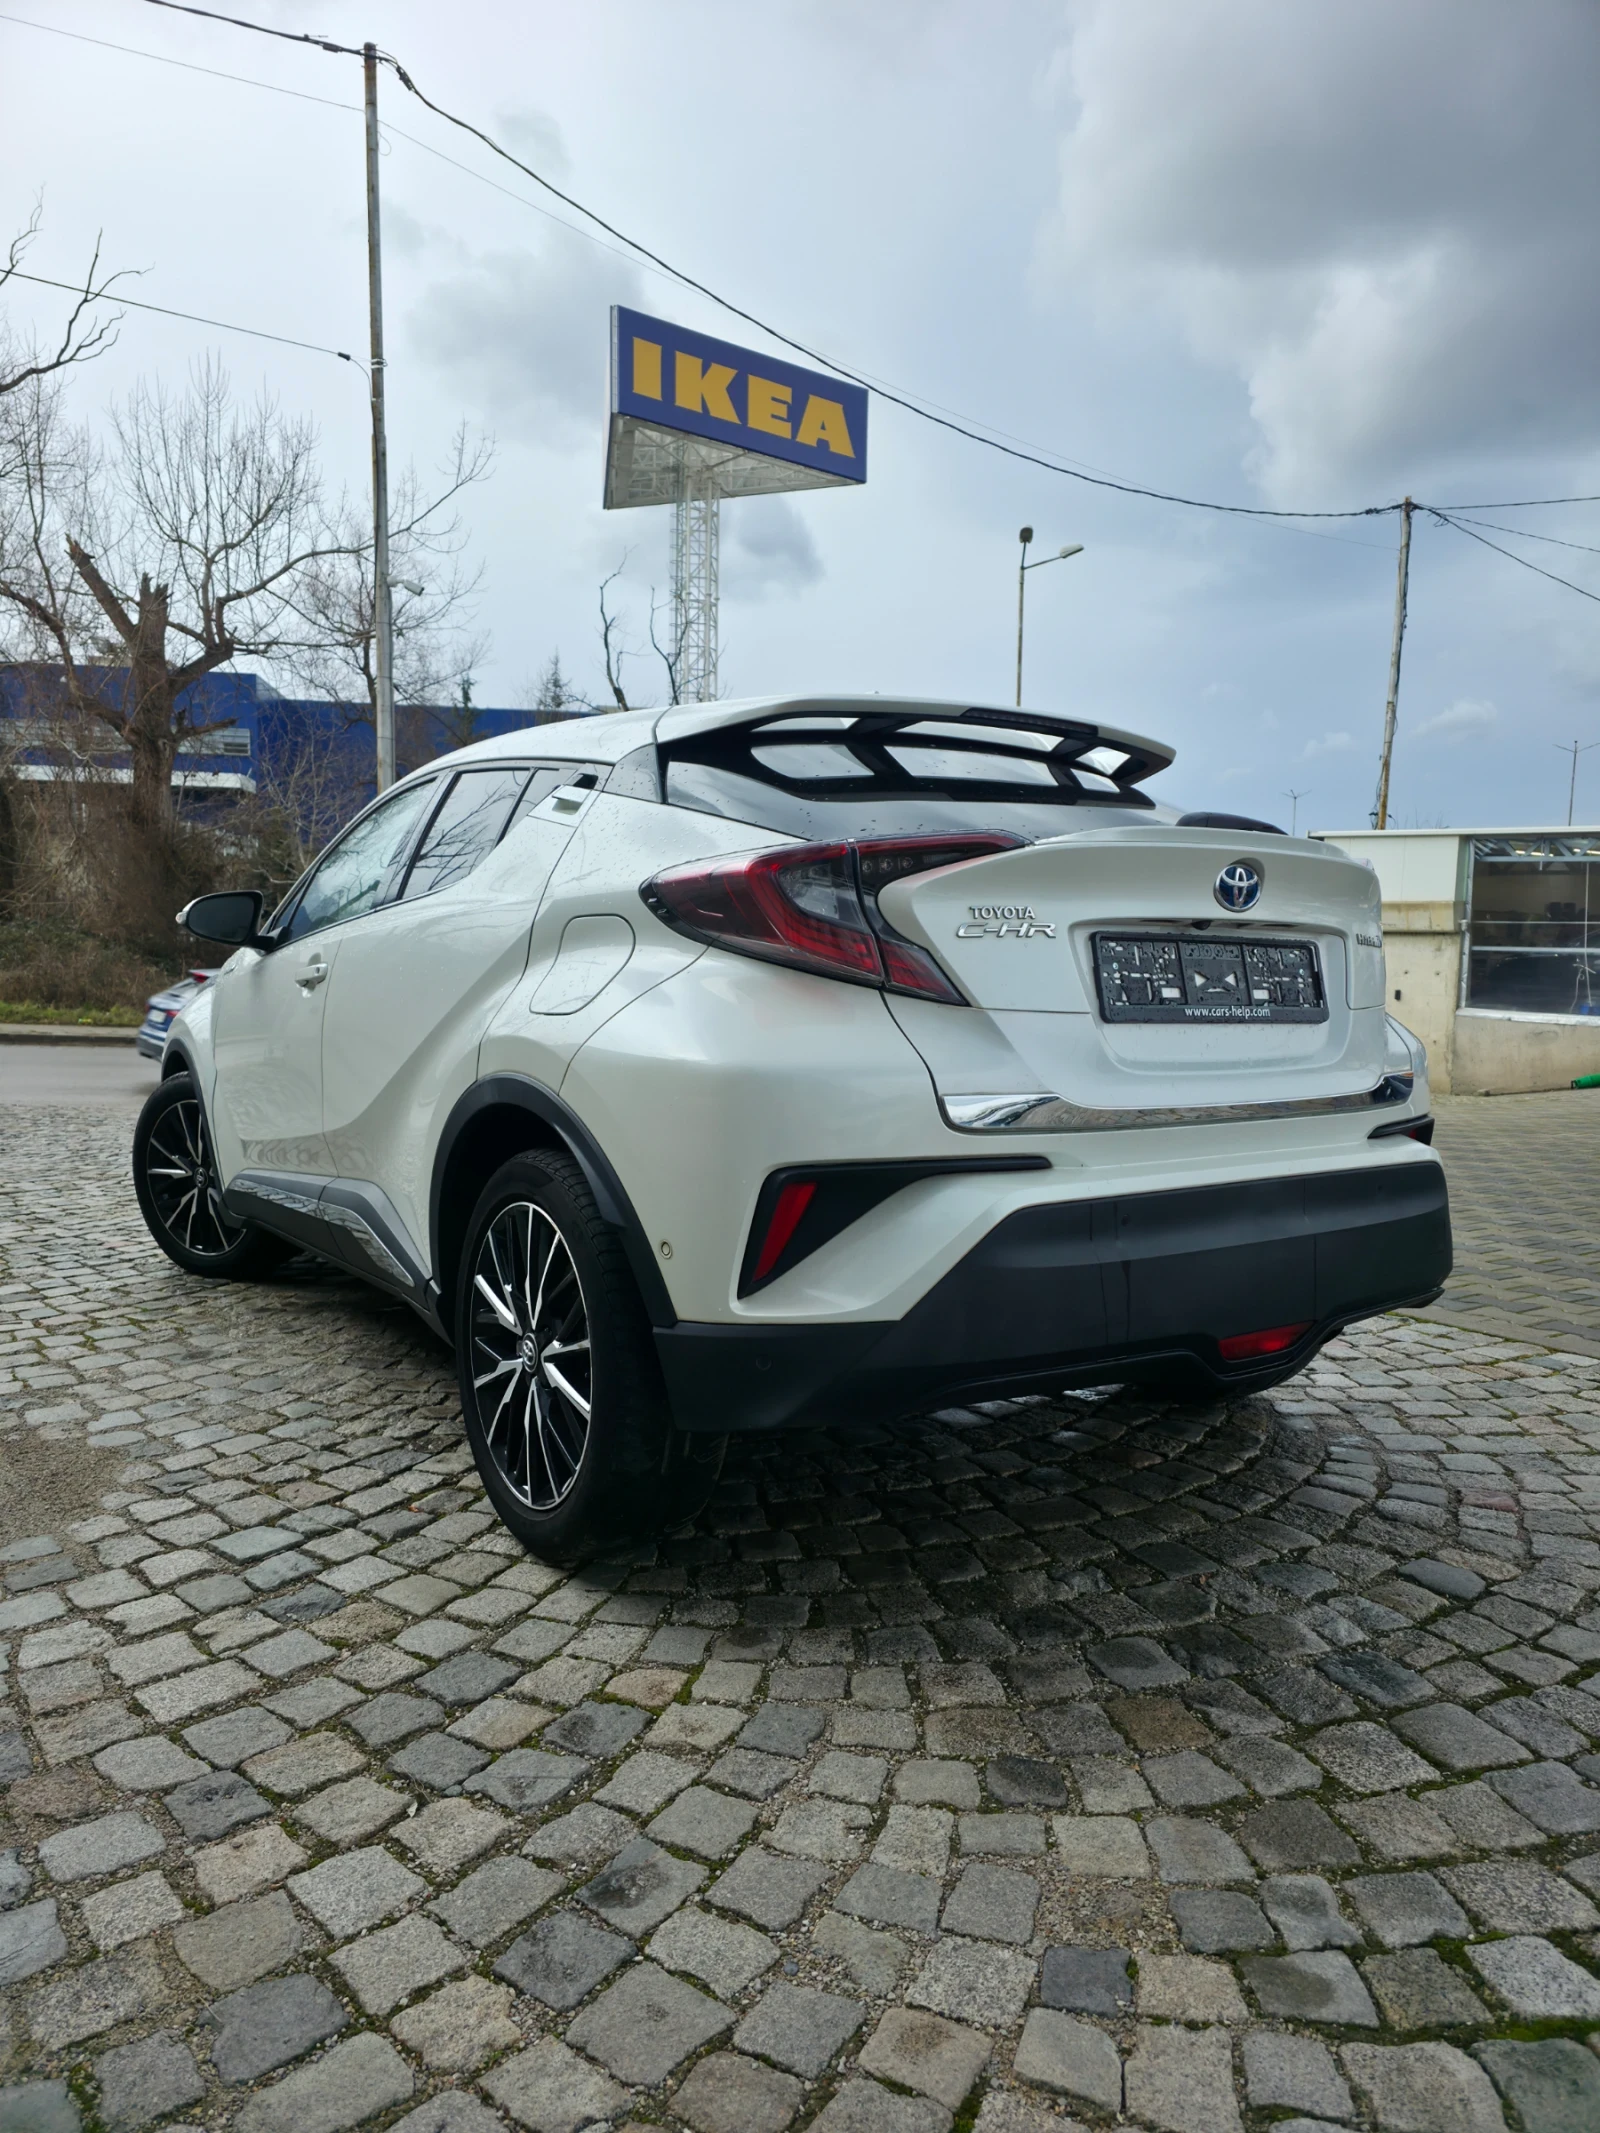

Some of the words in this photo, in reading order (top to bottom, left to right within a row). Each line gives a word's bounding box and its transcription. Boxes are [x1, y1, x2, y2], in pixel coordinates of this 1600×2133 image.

[632, 336, 856, 458] IKEA
[969, 906, 1035, 919] TOYOTA
[956, 922, 1056, 938] C-HR
[1184, 1005, 1271, 1020] www.cars-help.com
